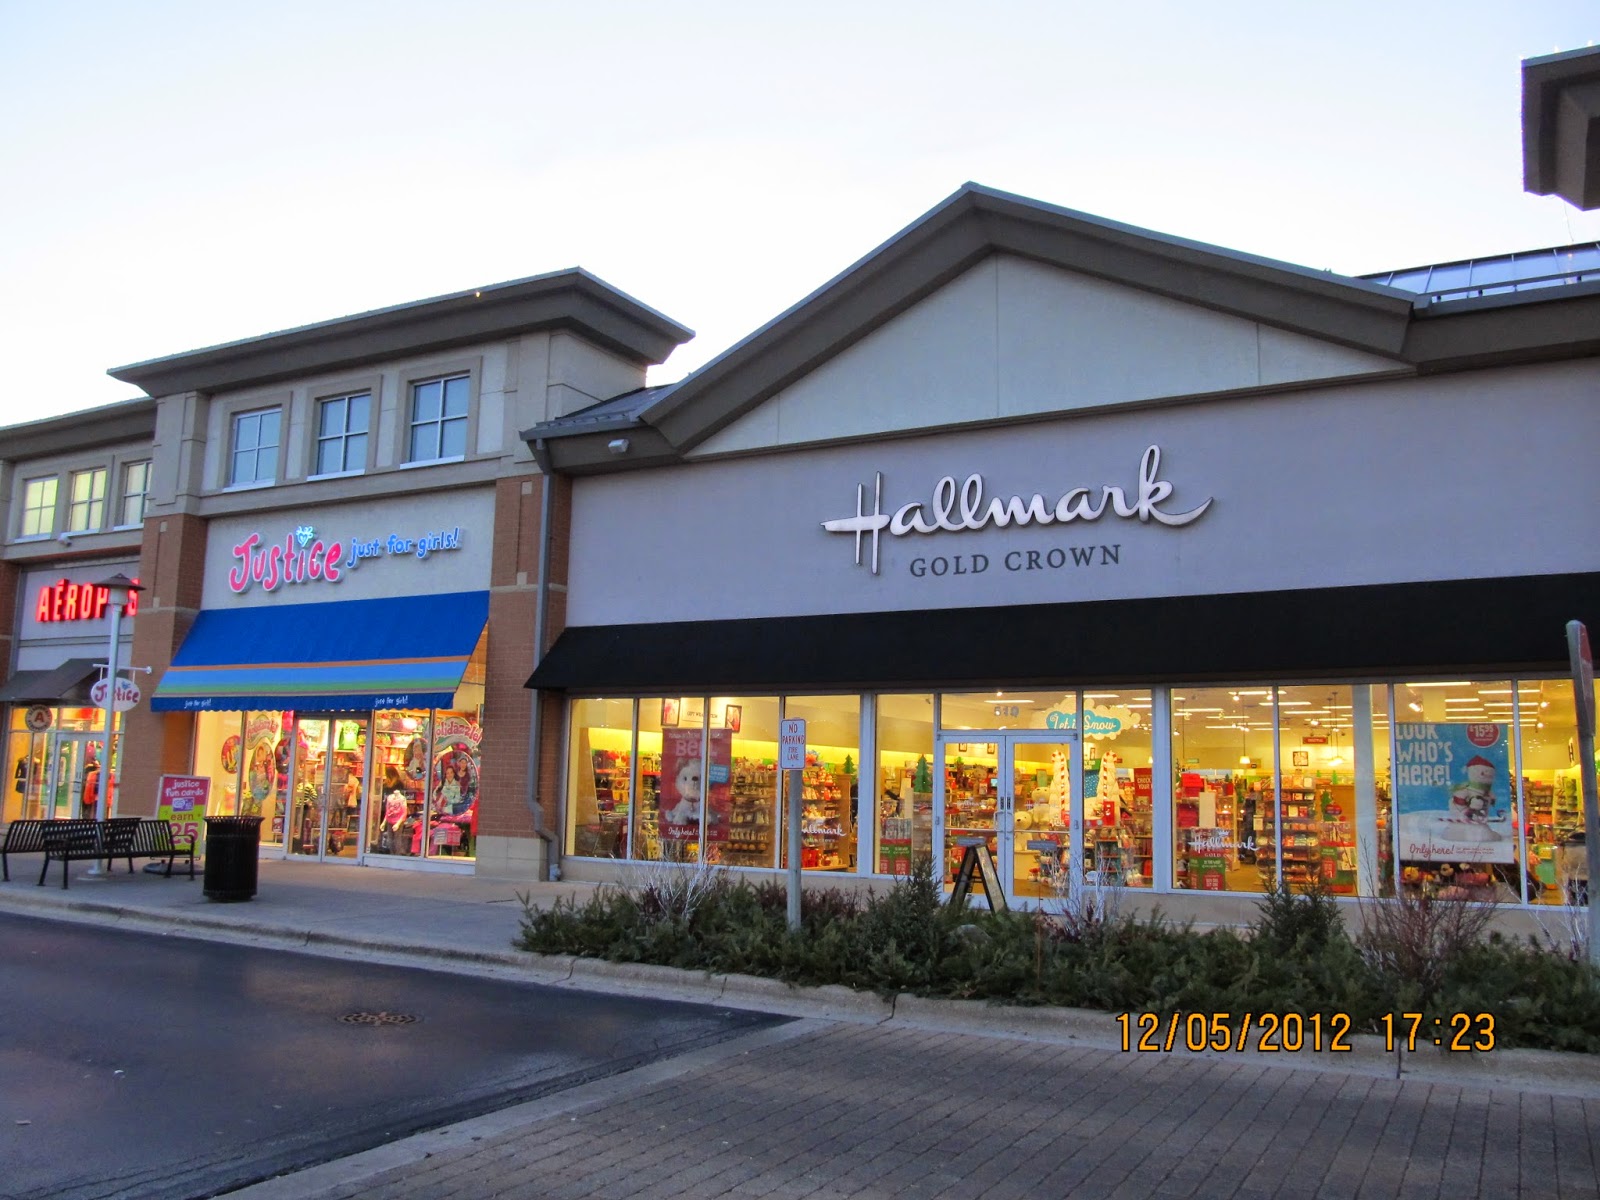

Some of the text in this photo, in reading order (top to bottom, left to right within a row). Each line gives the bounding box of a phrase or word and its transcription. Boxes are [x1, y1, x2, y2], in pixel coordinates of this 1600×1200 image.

[820, 444, 1214, 576] Hallmark
[346, 526, 459, 568] just for girls!
[229, 527, 343, 593] Justice
[909, 544, 1122, 578] GOLD CROWN
[36, 577, 140, 623] AÉROPS
[94, 683, 140, 703] Jtice
[35, 711, 44, 722] A
[1084, 714, 1116, 730] Snow
[788, 723, 798, 733] NO
[1396, 724, 1438, 740] LOOK
[782, 735, 805, 744] PARKING
[1396, 741, 1453, 762] WHO'S
[171, 779, 200, 789] justice
[169, 822, 199, 845] 25
[1188, 836, 1260, 853] Hallmark
[1409, 843, 1431, 858] Only
[1432, 844, 1454, 855] here!
